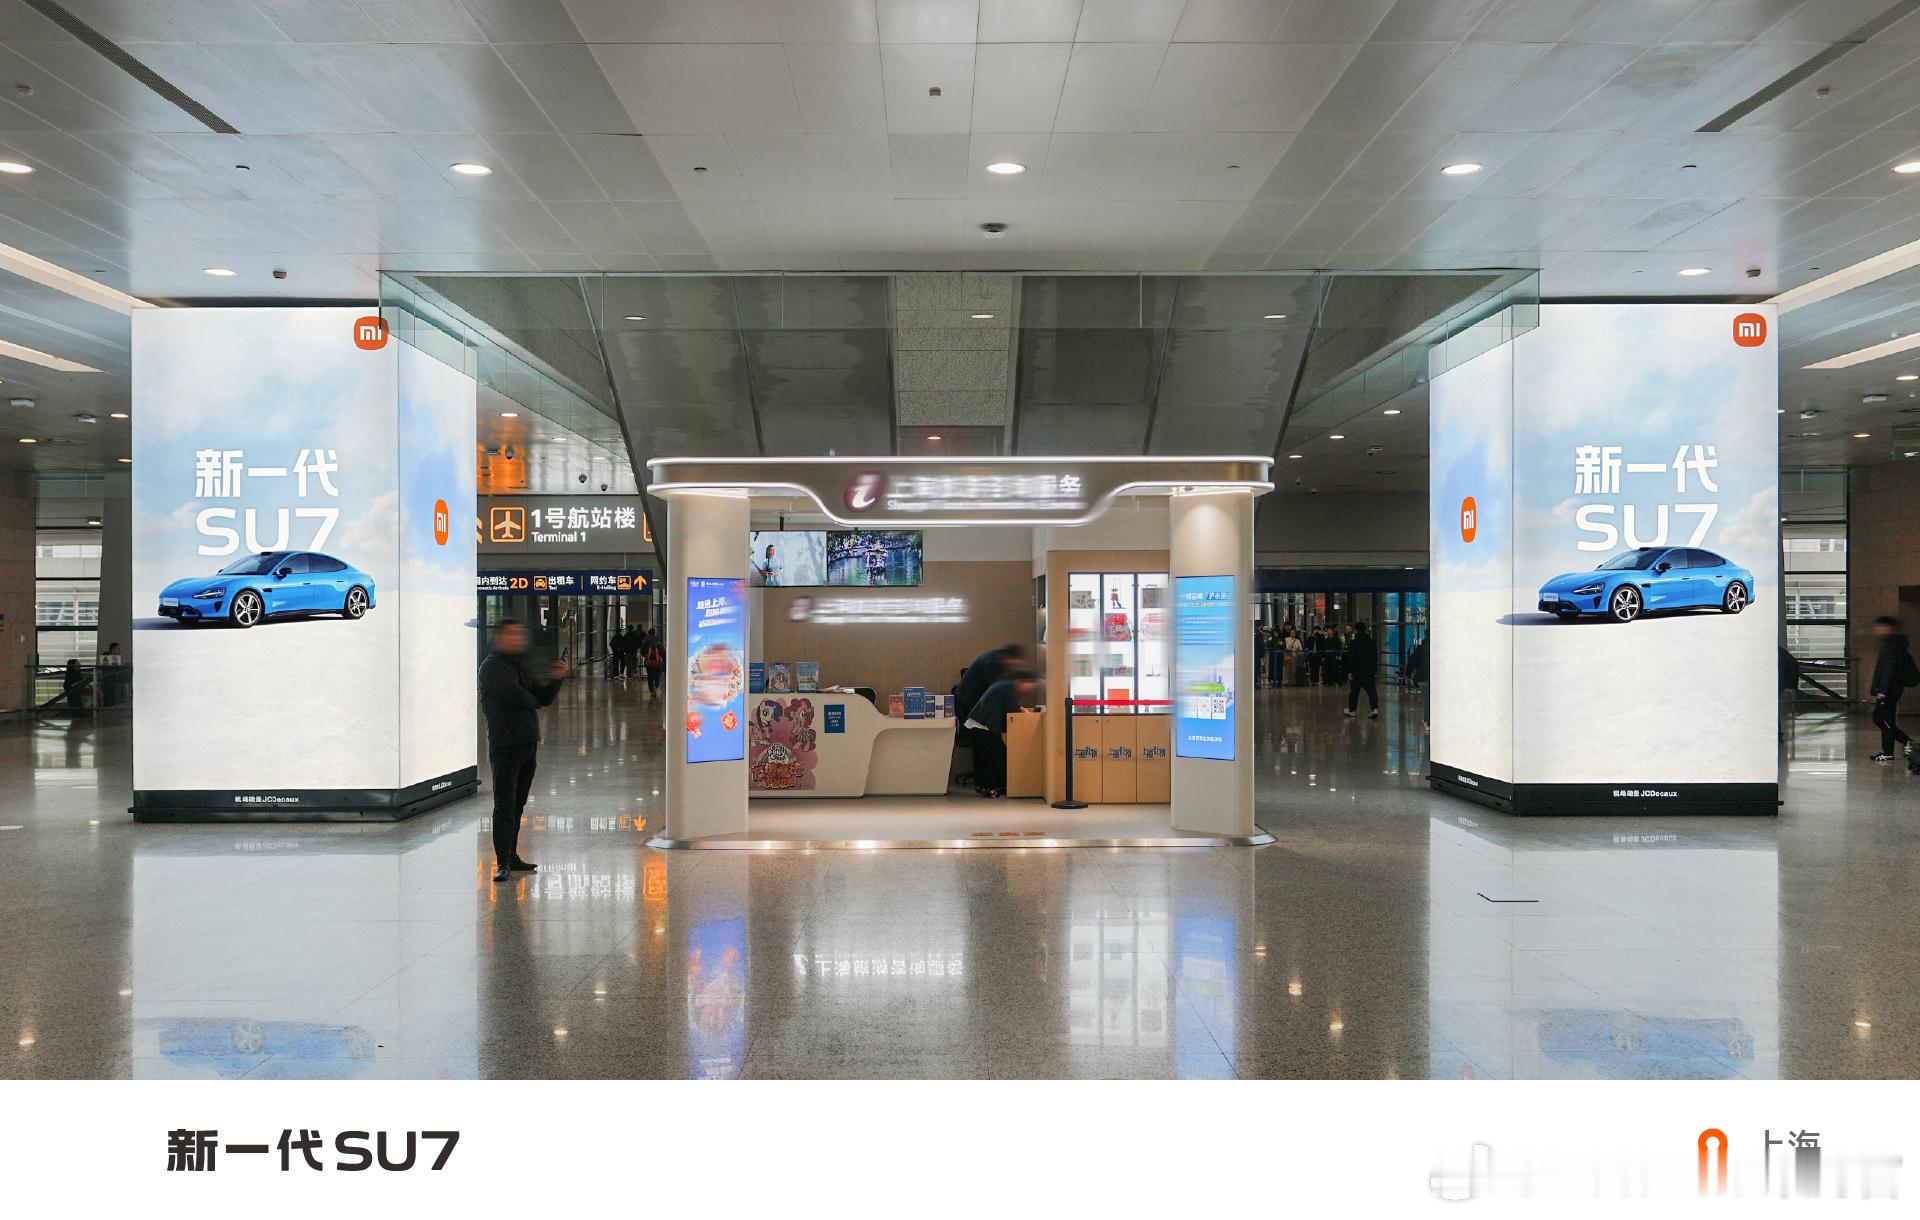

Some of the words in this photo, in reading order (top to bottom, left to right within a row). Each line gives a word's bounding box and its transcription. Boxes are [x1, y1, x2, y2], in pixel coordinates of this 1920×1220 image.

[195, 449, 339, 497] 新一代
[1575, 445, 1718, 494] 新一代
[196, 507, 339, 556] SU7
[531, 506, 636, 530] 1号航站楼
[1576, 503, 1718, 551] SU7
[531, 531, 577, 543] Terminal
[579, 531, 587, 543] 1
[509, 577, 529, 590] 2D
[548, 576, 574, 586] 出租车
[590, 576, 617, 586] 网约车
[1641, 789, 1678, 797] JCDecaux
